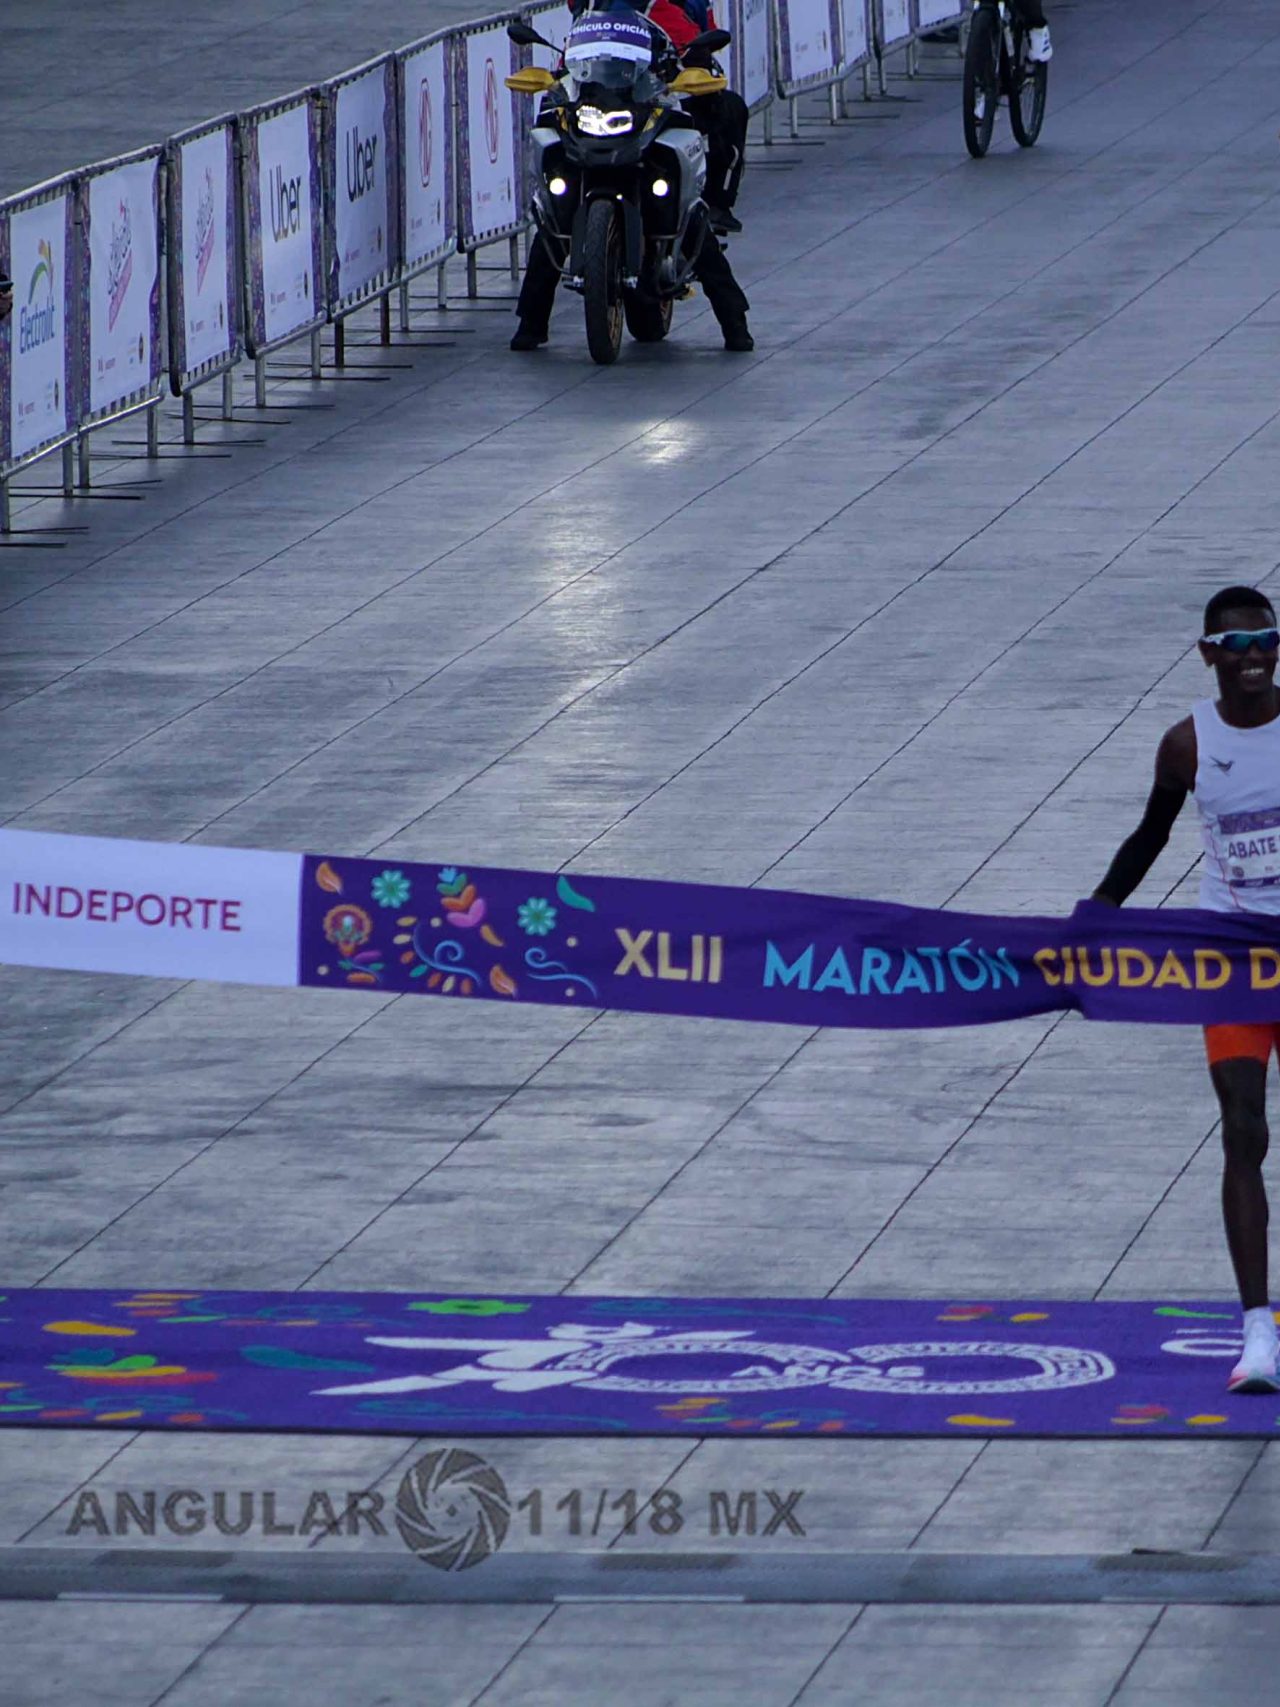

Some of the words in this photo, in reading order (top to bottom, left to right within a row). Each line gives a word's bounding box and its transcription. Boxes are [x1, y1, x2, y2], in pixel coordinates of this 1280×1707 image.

[613, 23, 651, 37] OFICIAL
[345, 125, 377, 203] Uber
[269, 163, 301, 243] Uber
[1228, 835, 1278, 859] ABATE
[11, 881, 242, 932] INDEPORTE
[613, 928, 723, 984] XLII
[762, 938, 1020, 996] MARATÓN
[1032, 945, 1232, 991] CIUDAD
